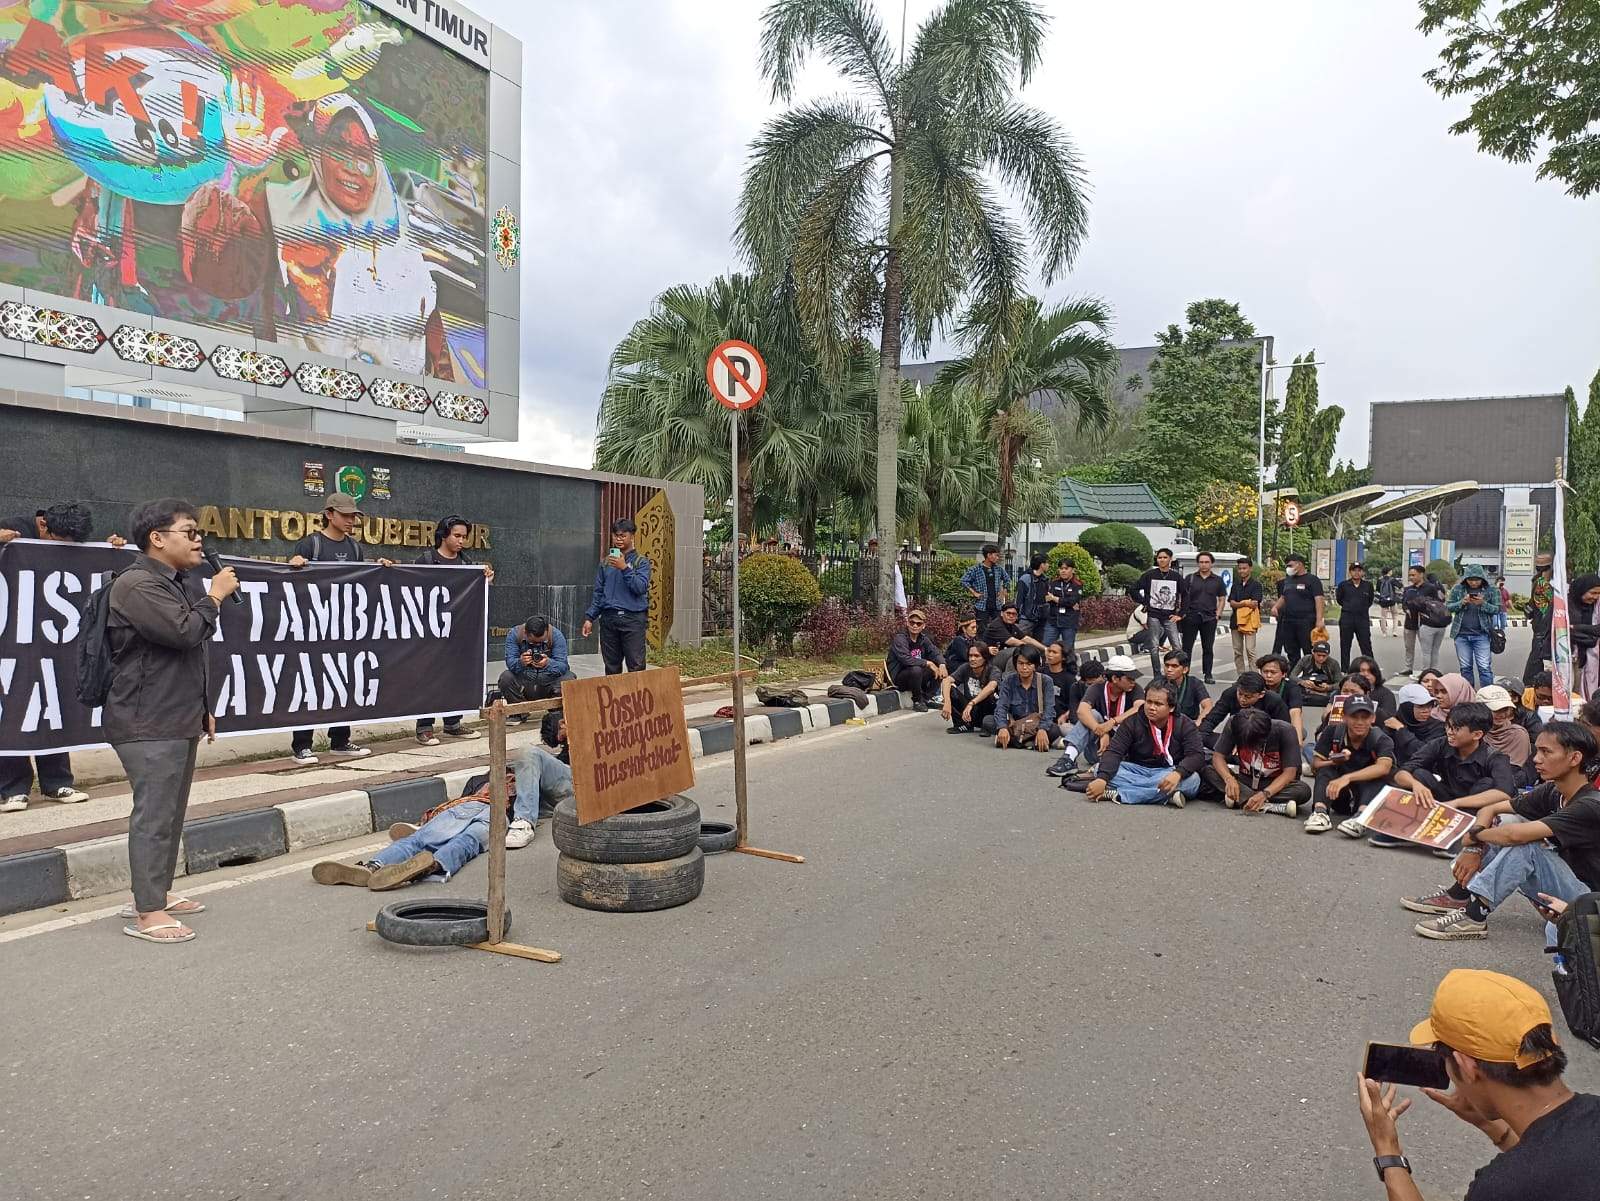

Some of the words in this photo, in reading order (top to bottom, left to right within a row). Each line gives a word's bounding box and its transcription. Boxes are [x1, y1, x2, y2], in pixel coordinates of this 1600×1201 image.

[424, 1, 488, 56] TIMUR
[728, 355, 751, 396] P
[197, 505, 326, 541] ANTOR
[350, 515, 492, 550] GUBERUR
[240, 581, 452, 641] TAMBANG
